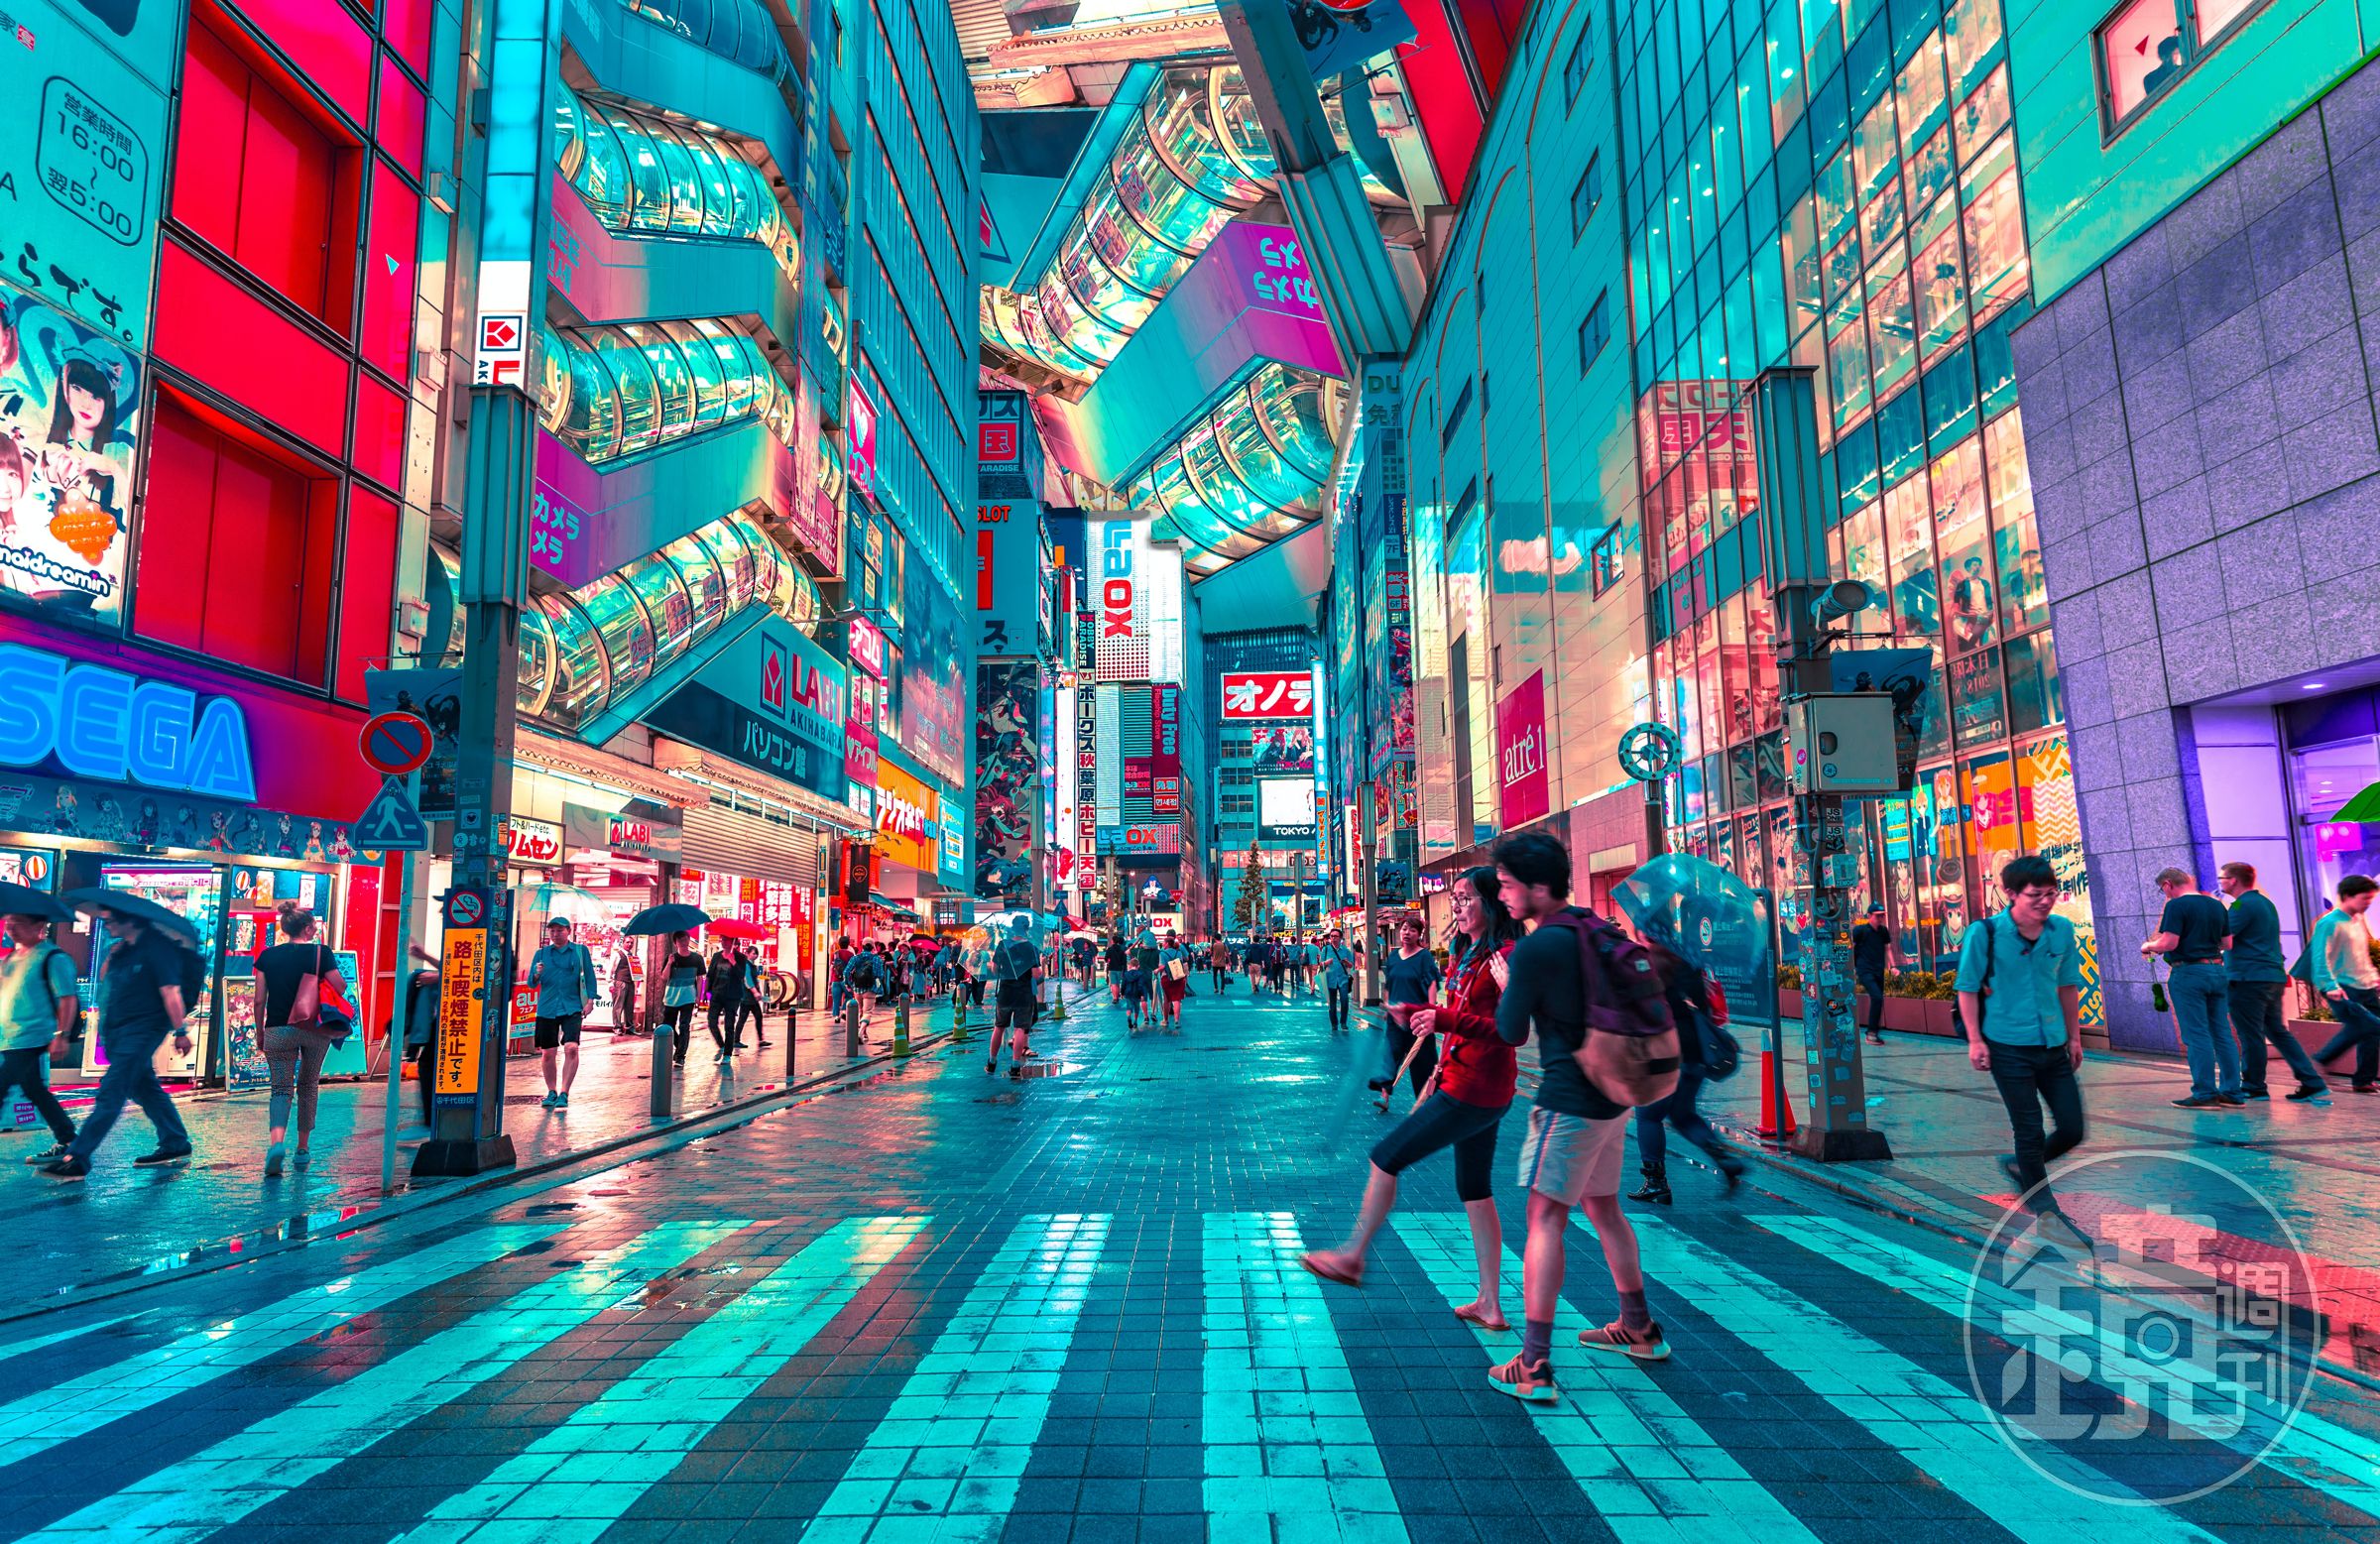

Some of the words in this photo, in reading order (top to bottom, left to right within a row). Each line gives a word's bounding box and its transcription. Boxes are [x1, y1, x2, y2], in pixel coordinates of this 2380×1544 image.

[63, 91, 132, 156] 営業時間
[58, 111, 134, 182] 16:00
[48, 167, 132, 237] 翌5:00
[978, 463, 1019, 473] ARADISE
[534, 491, 580, 540] カメラ
[532, 530, 563, 565] メラ
[1389, 599, 1400, 609] 6F
[1078, 614, 1087, 666] PARADISE
[791, 653, 843, 728] LABI
[1161, 688, 1177, 724] Duty
[0, 642, 258, 802] SEGA
[790, 712, 843, 753] AKIHABARA
[1161, 724, 1177, 756] Free
[743, 720, 806, 781] パソコン館
[854, 739, 878, 773] アイフル
[623, 821, 652, 843] LABI
[1273, 827, 1310, 836] TOKYO
[742, 878, 752, 901] FREE
[472, 933, 484, 983] 千代田区内は
[447, 940, 473, 1088] 路上喫煙禁止です。
[516, 992, 538, 1007] au
[442, 1095, 476, 1105] 千代田区
